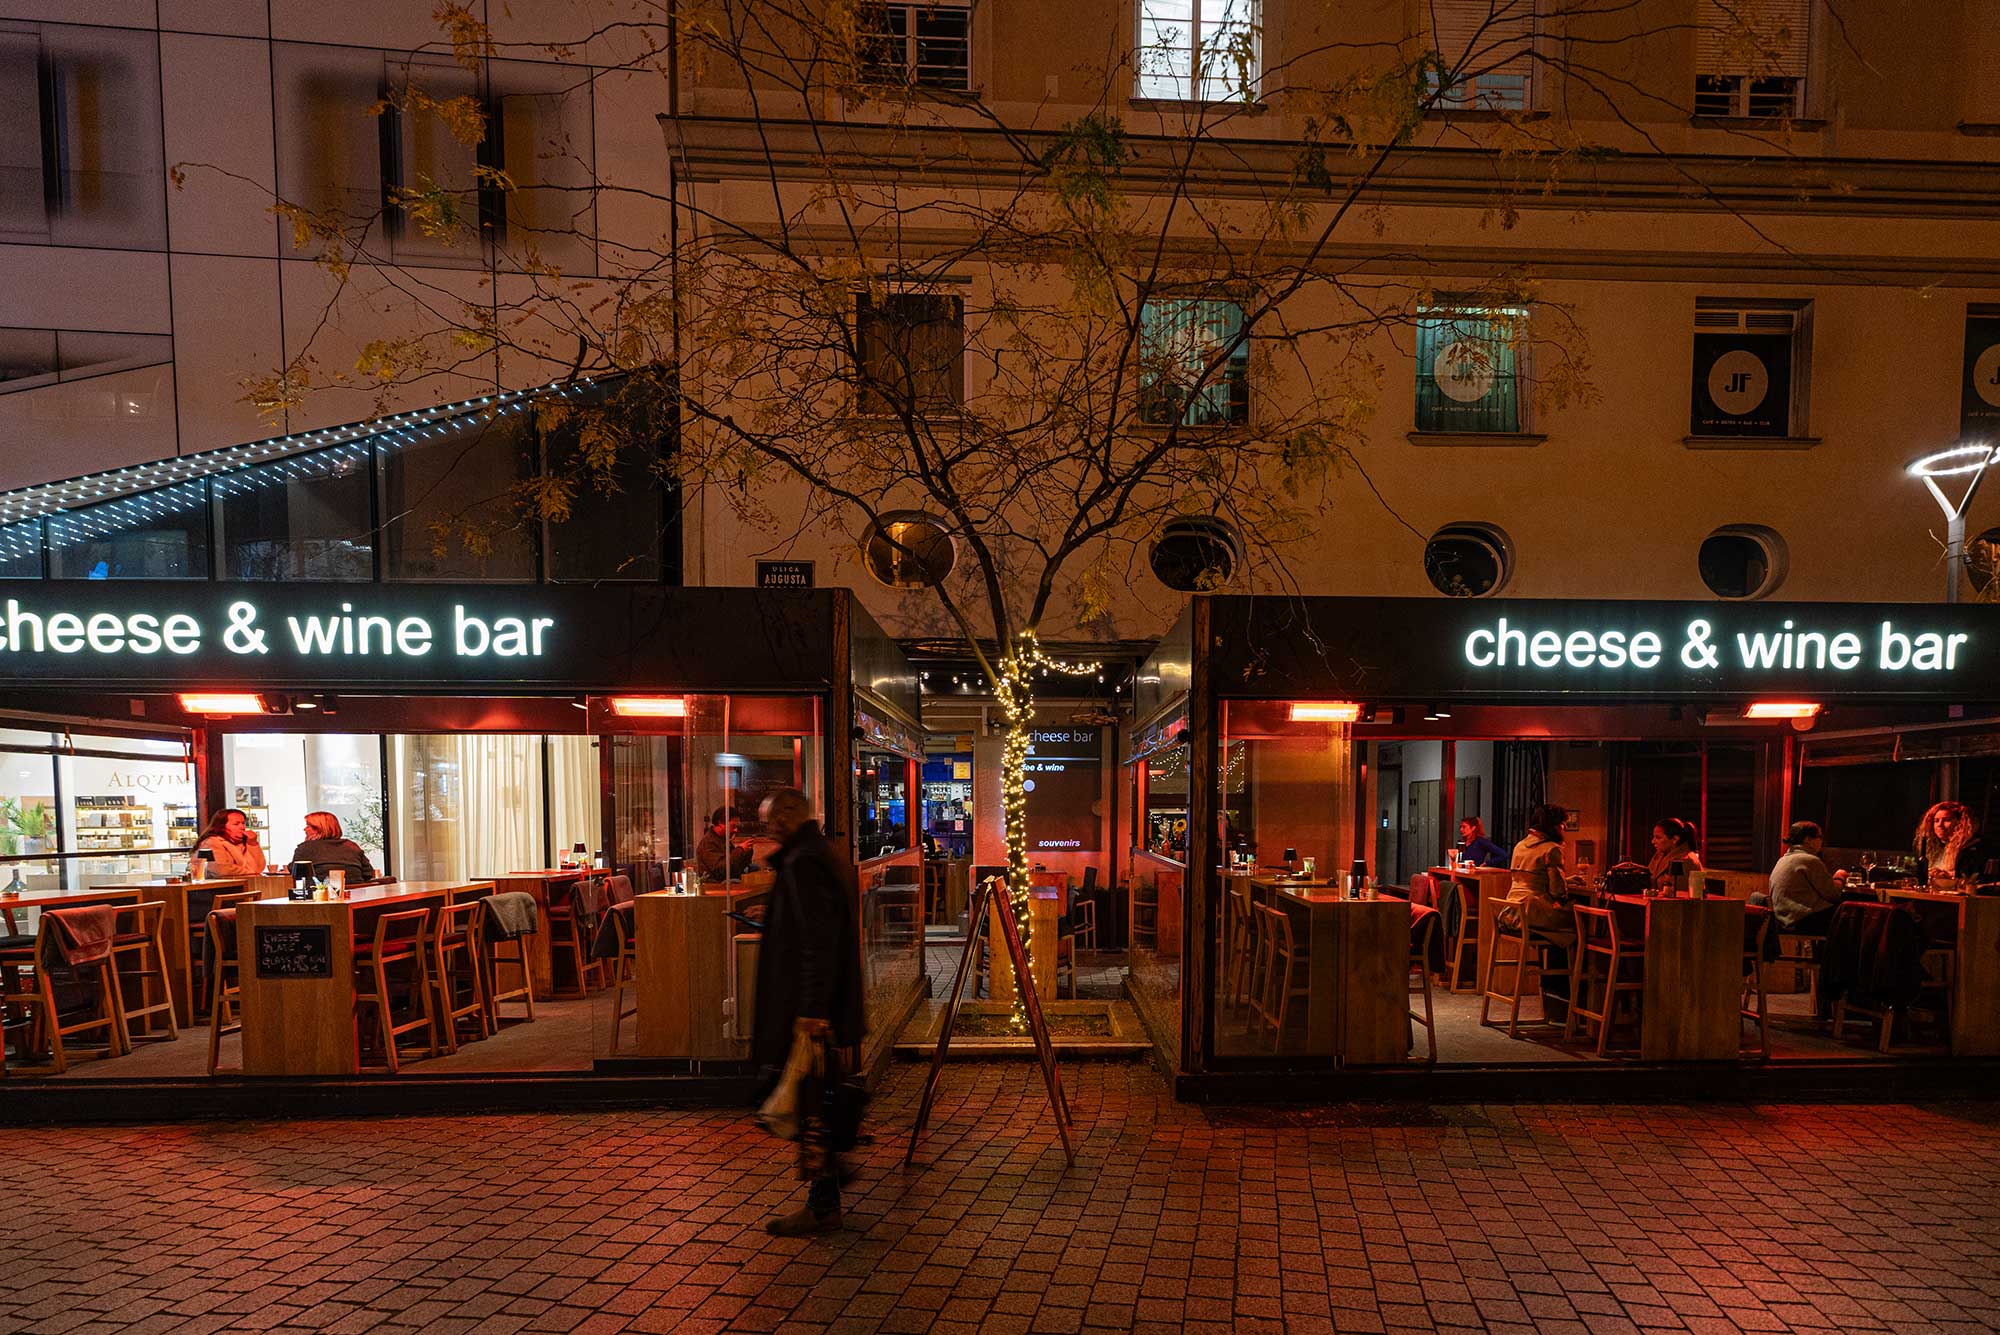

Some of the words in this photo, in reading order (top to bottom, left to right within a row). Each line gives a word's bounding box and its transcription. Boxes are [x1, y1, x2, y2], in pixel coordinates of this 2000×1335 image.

[1724, 373, 1752, 393] JF
[772, 565, 800, 573] ULICA
[764, 574, 807, 585] AUGUSTA
[0, 599, 201, 655] heese
[222, 600, 270, 655] &
[287, 602, 433, 656] wine
[454, 604, 554, 657] bar
[1464, 617, 1662, 668] cheese
[1680, 618, 1720, 669] &
[1736, 619, 1861, 670] wine
[1879, 620, 1968, 671] bar
[1028, 729, 1071, 742] cheese
[1073, 729, 1094, 742] bar
[1036, 763, 1044, 771] &
[1045, 763, 1065, 771] wine
[1038, 838, 1081, 848] souvenirs
